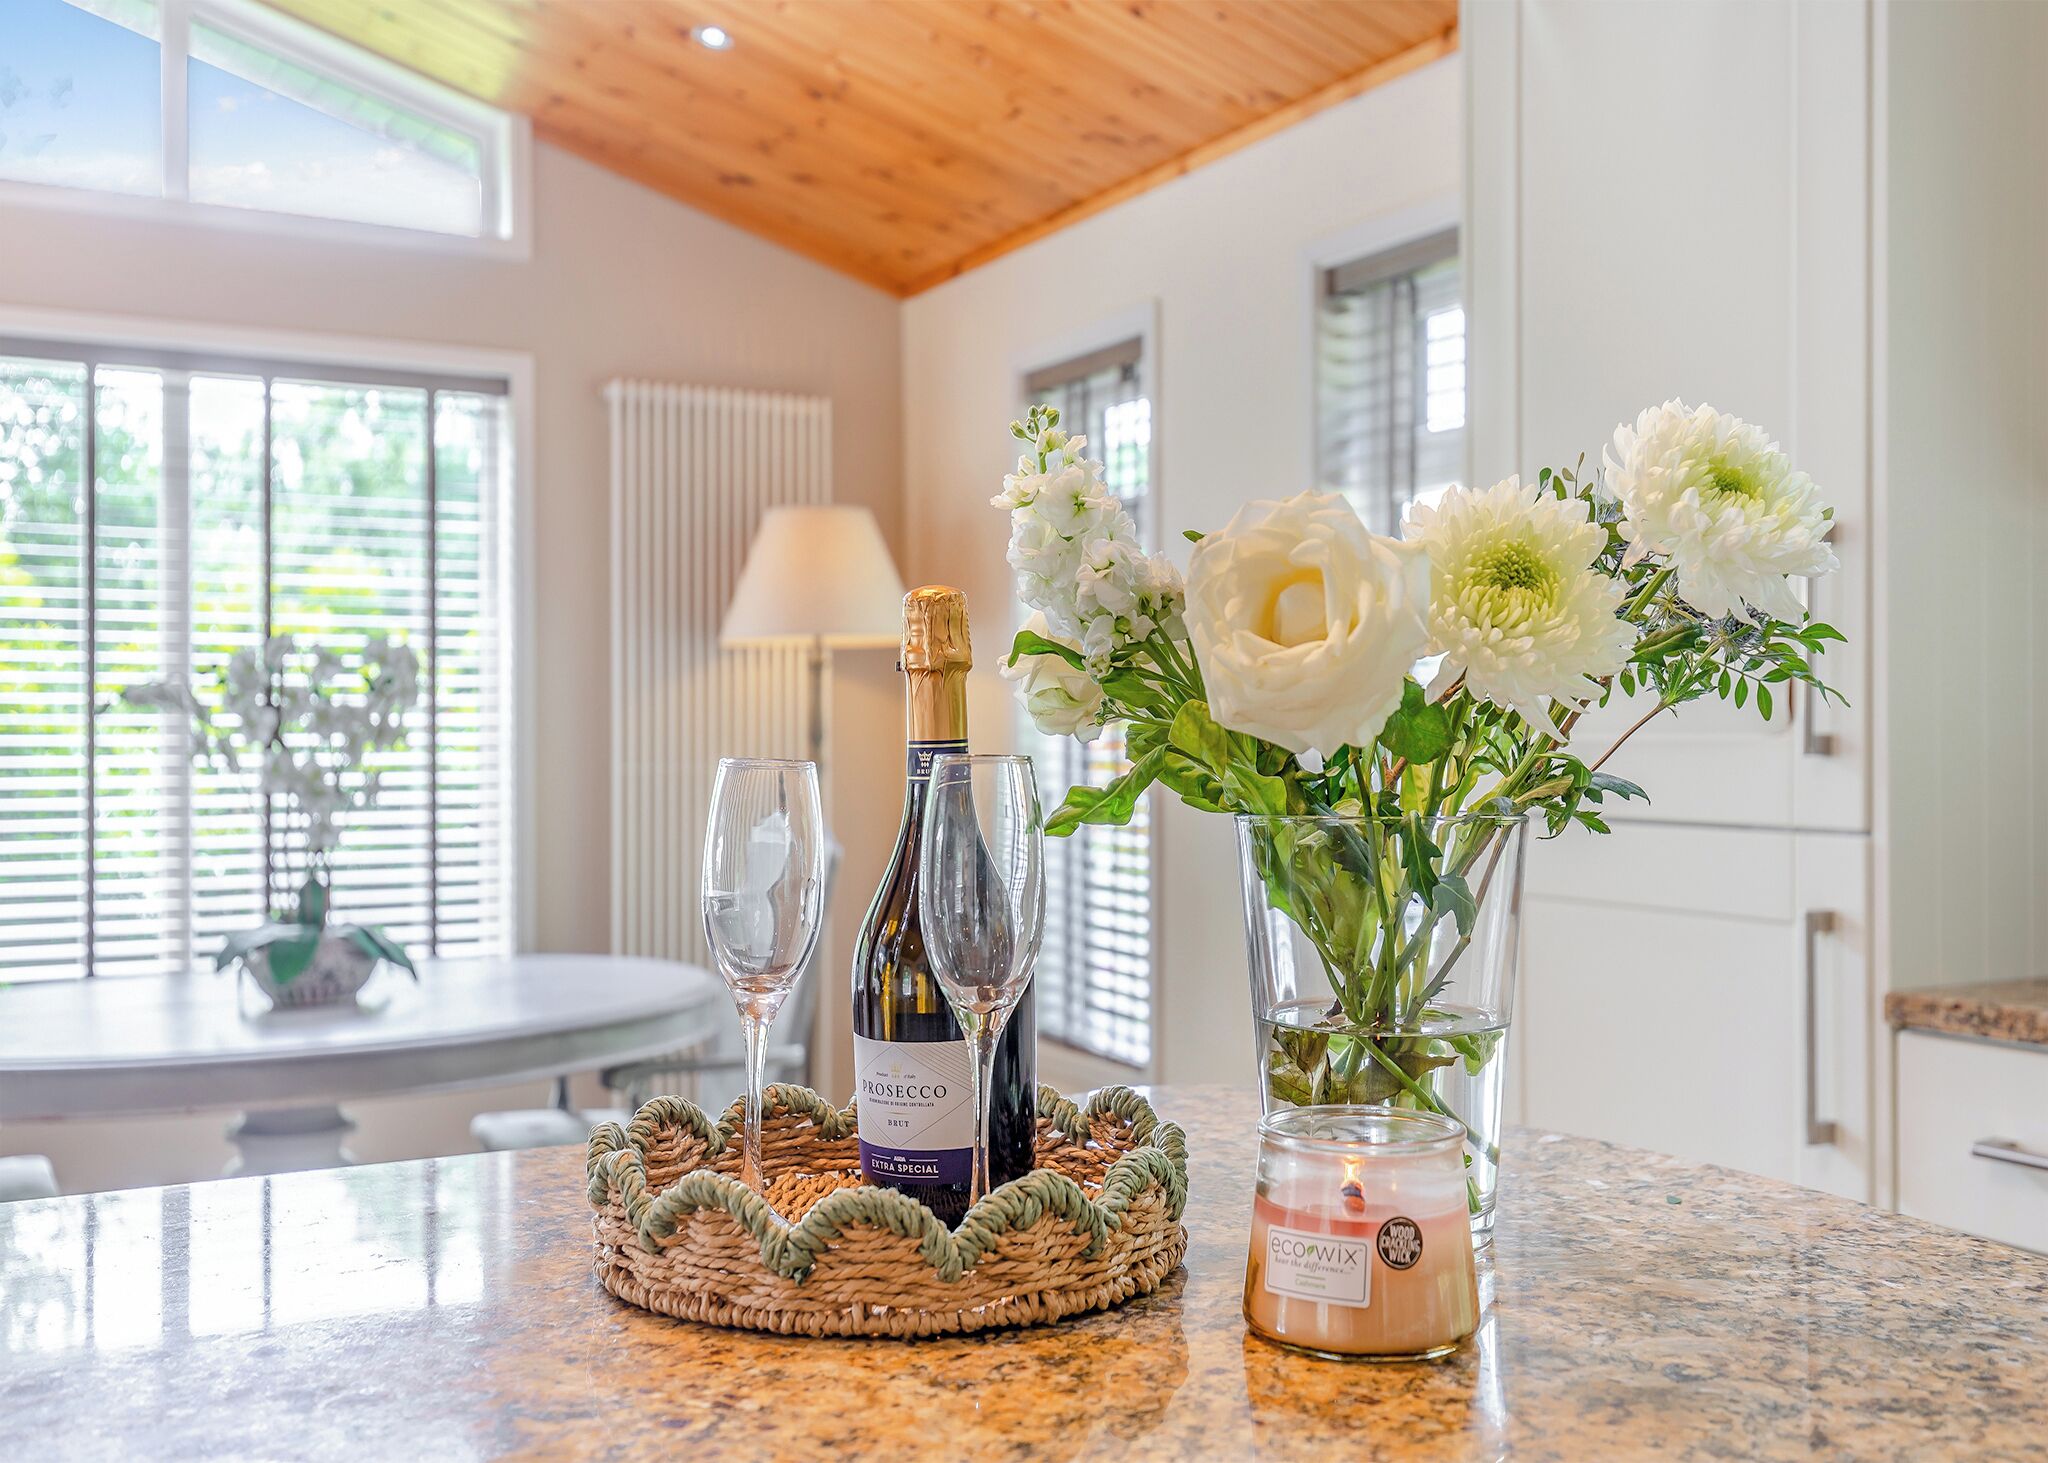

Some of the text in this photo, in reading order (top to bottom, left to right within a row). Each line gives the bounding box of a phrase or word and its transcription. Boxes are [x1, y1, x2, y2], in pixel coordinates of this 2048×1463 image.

[862, 1079, 947, 1099] PROSECCO
[887, 1119, 910, 1128] BRUT
[871, 1158, 939, 1174] EXTRA SPECIAL
[1389, 1224, 1415, 1241] WOOD
[1388, 1247, 1411, 1263] WICK
